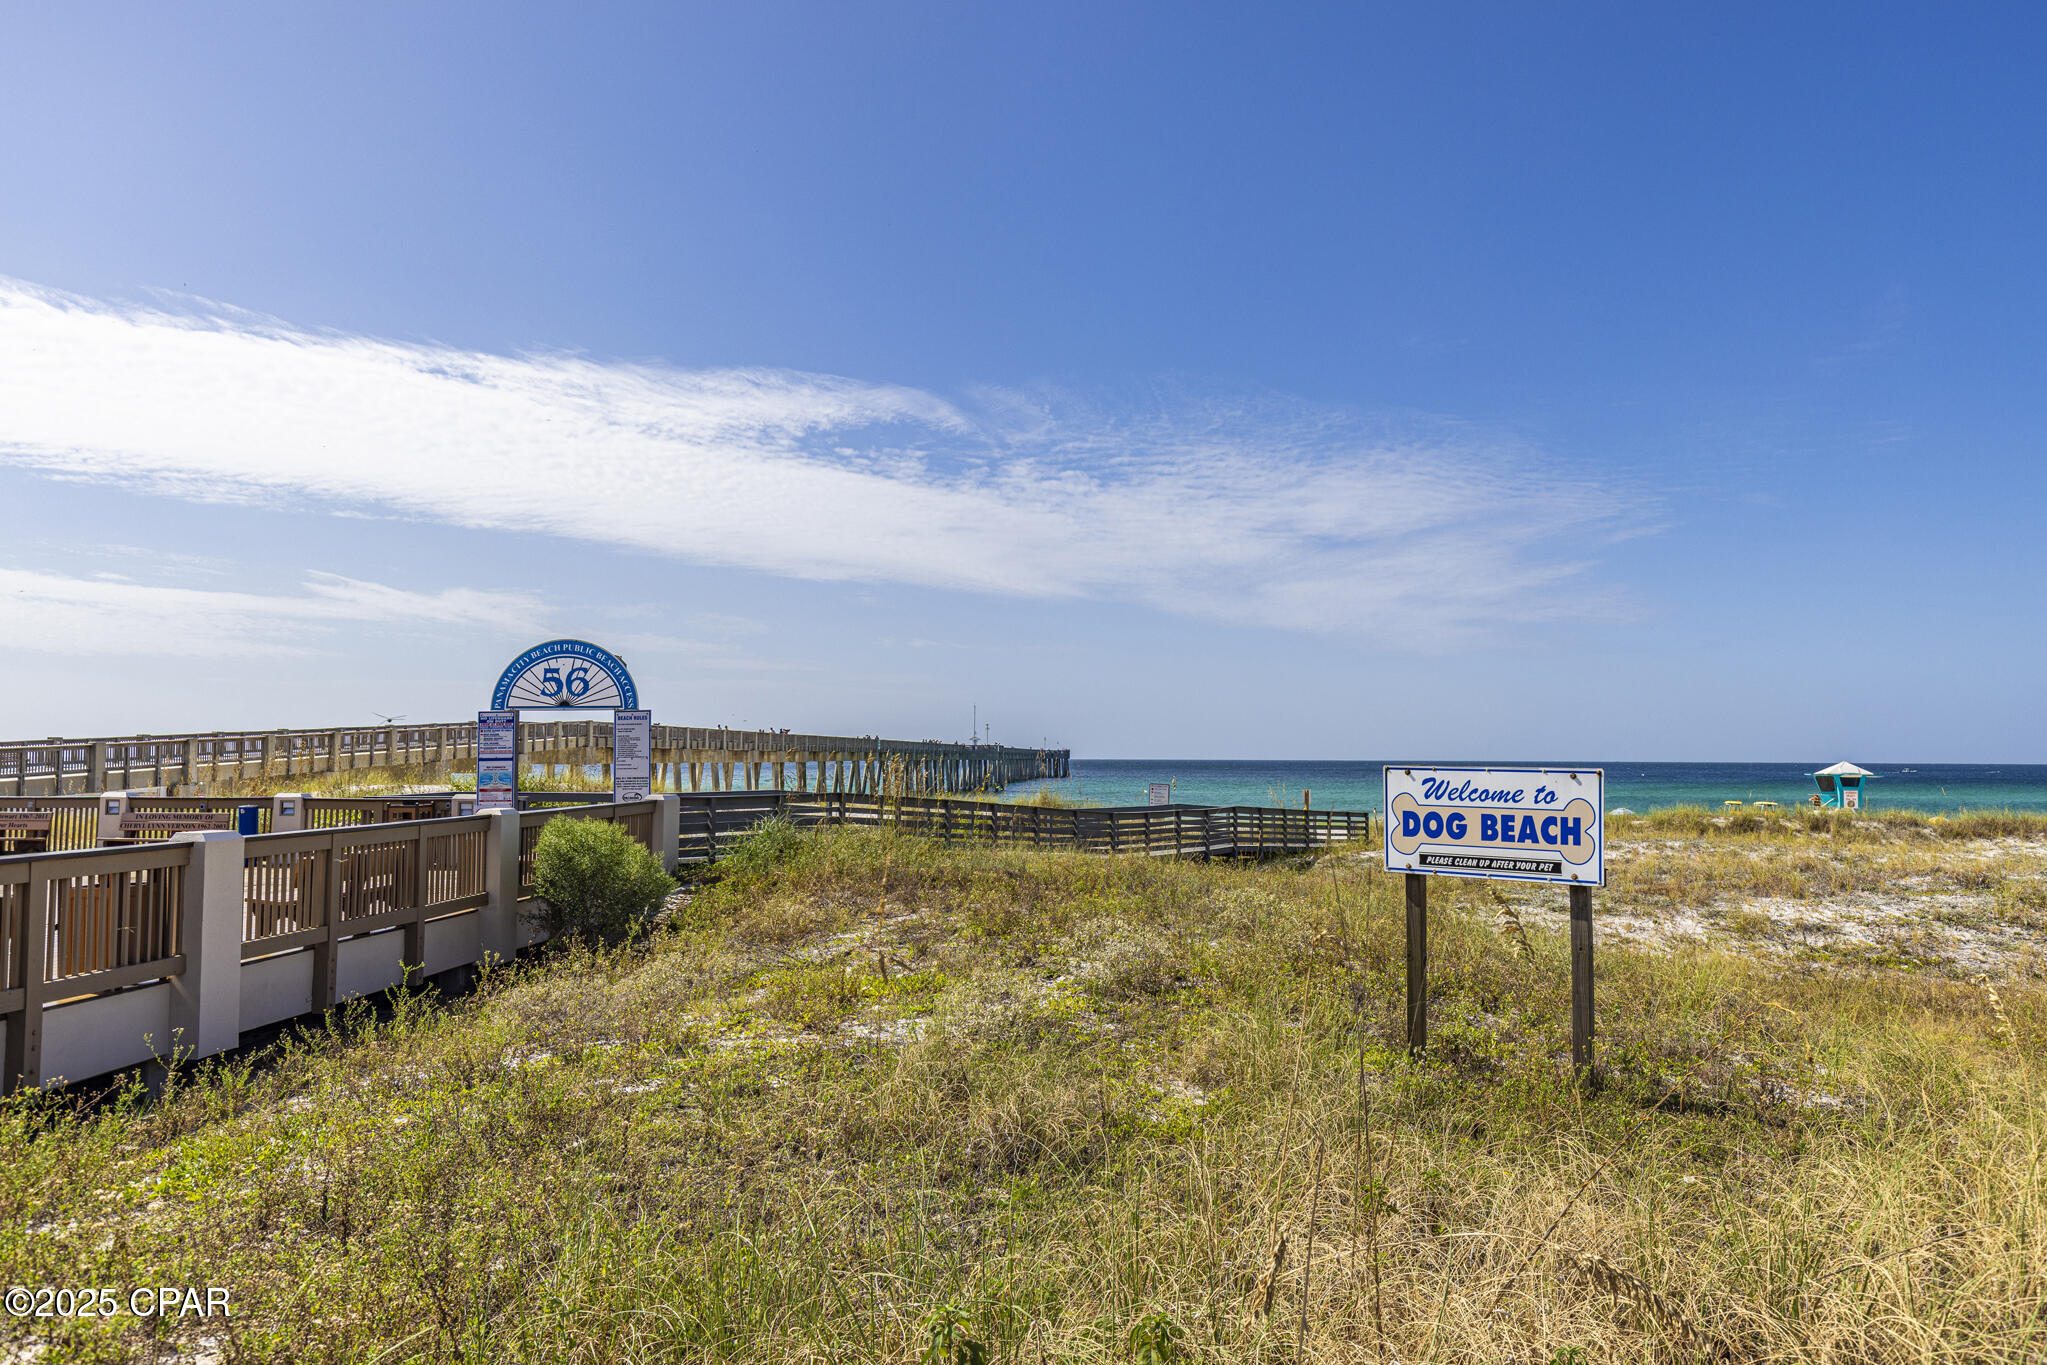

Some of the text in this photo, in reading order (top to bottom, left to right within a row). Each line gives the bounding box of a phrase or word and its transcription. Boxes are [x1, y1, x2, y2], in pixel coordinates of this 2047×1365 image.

[530, 644, 560, 659] BEACH
[563, 643, 596, 655] PUBLIC
[596, 651, 622, 676] BEACH
[620, 675, 635, 709] ACCESS
[540, 667, 590, 697] 56
[1421, 777, 1559, 805] Welcome to
[1402, 810, 1582, 846] DOG BEACH
[1426, 855, 1554, 872] PLEASE CLEAN UP AFTER YOUR PET
